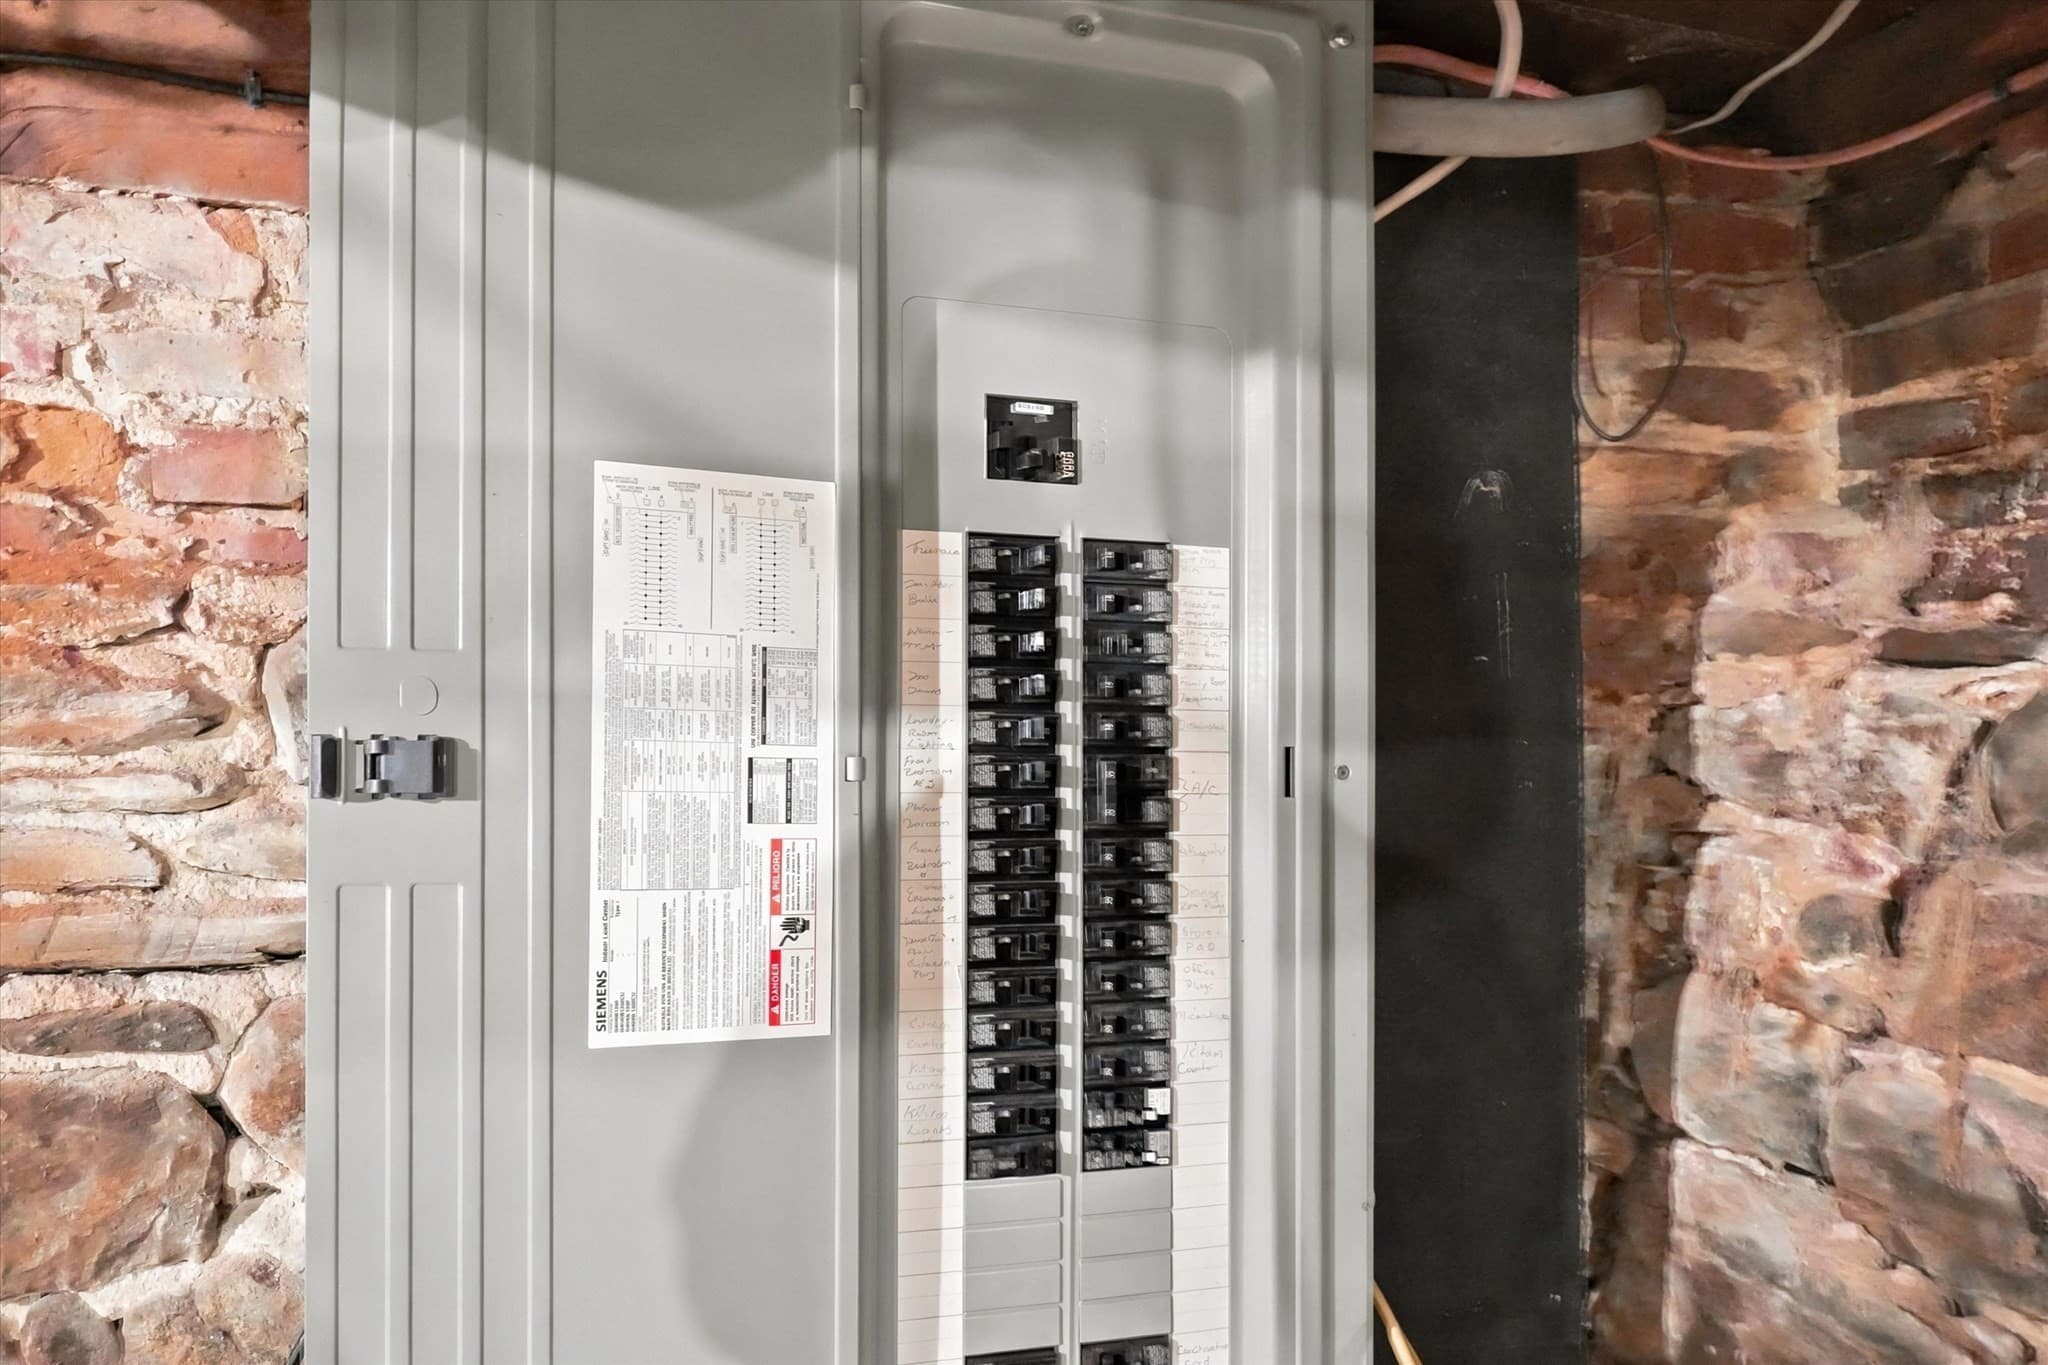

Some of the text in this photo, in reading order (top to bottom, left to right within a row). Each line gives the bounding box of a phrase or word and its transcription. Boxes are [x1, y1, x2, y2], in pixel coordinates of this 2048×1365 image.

[1192, 780, 1219, 798] A/C
[772, 850, 780, 891] PELIGRO
[595, 970, 607, 1032] SIEMENS
[771, 963, 779, 1002] DANGER
